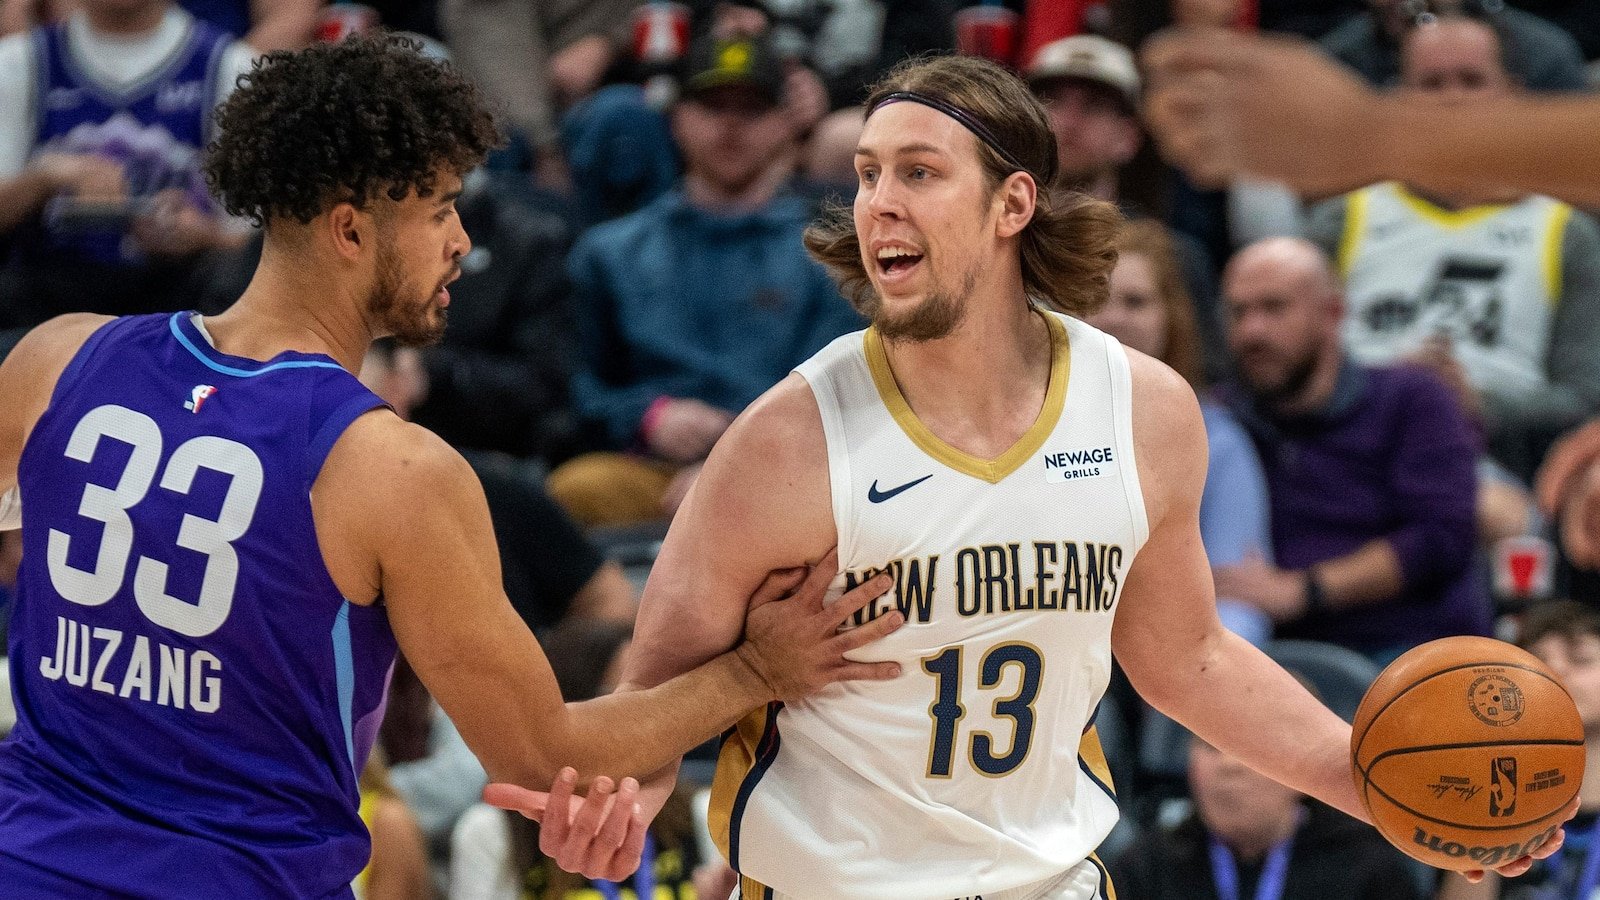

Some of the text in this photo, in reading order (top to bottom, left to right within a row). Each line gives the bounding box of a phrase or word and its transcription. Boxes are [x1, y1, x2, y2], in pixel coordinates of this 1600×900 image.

[1044, 447, 1113, 469] NEWAGE
[1064, 467, 1100, 479] GRILLS
[47, 404, 263, 637] 33
[955, 541, 1123, 616] ORLEANS
[40, 616, 221, 713] JUZANG
[920, 640, 1045, 779] 13
